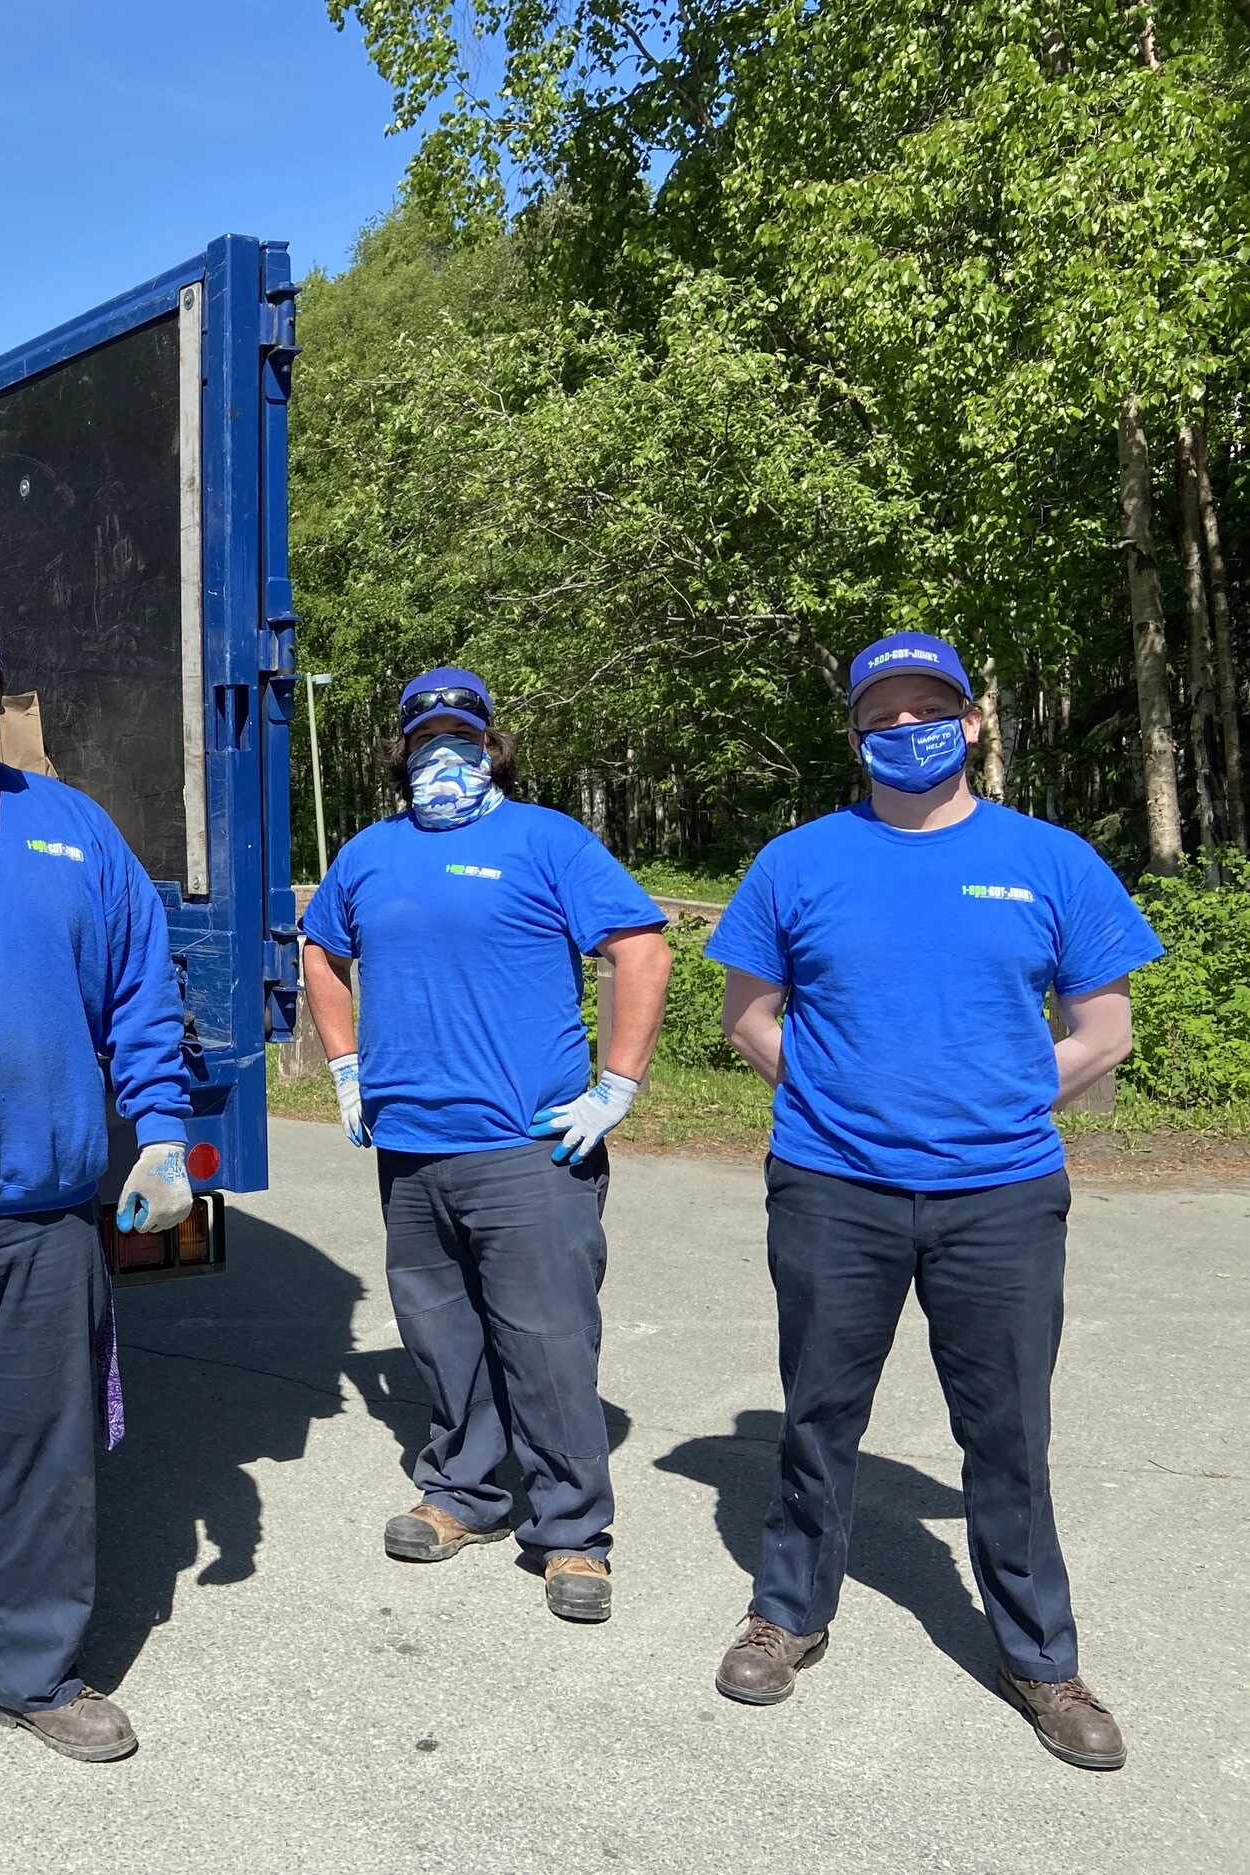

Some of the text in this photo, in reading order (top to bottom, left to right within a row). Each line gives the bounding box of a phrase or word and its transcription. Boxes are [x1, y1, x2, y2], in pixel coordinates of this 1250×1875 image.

[867, 648, 940, 669] 1-800-GOT-JUNK?
[917, 732, 951, 745] HAPPY TO
